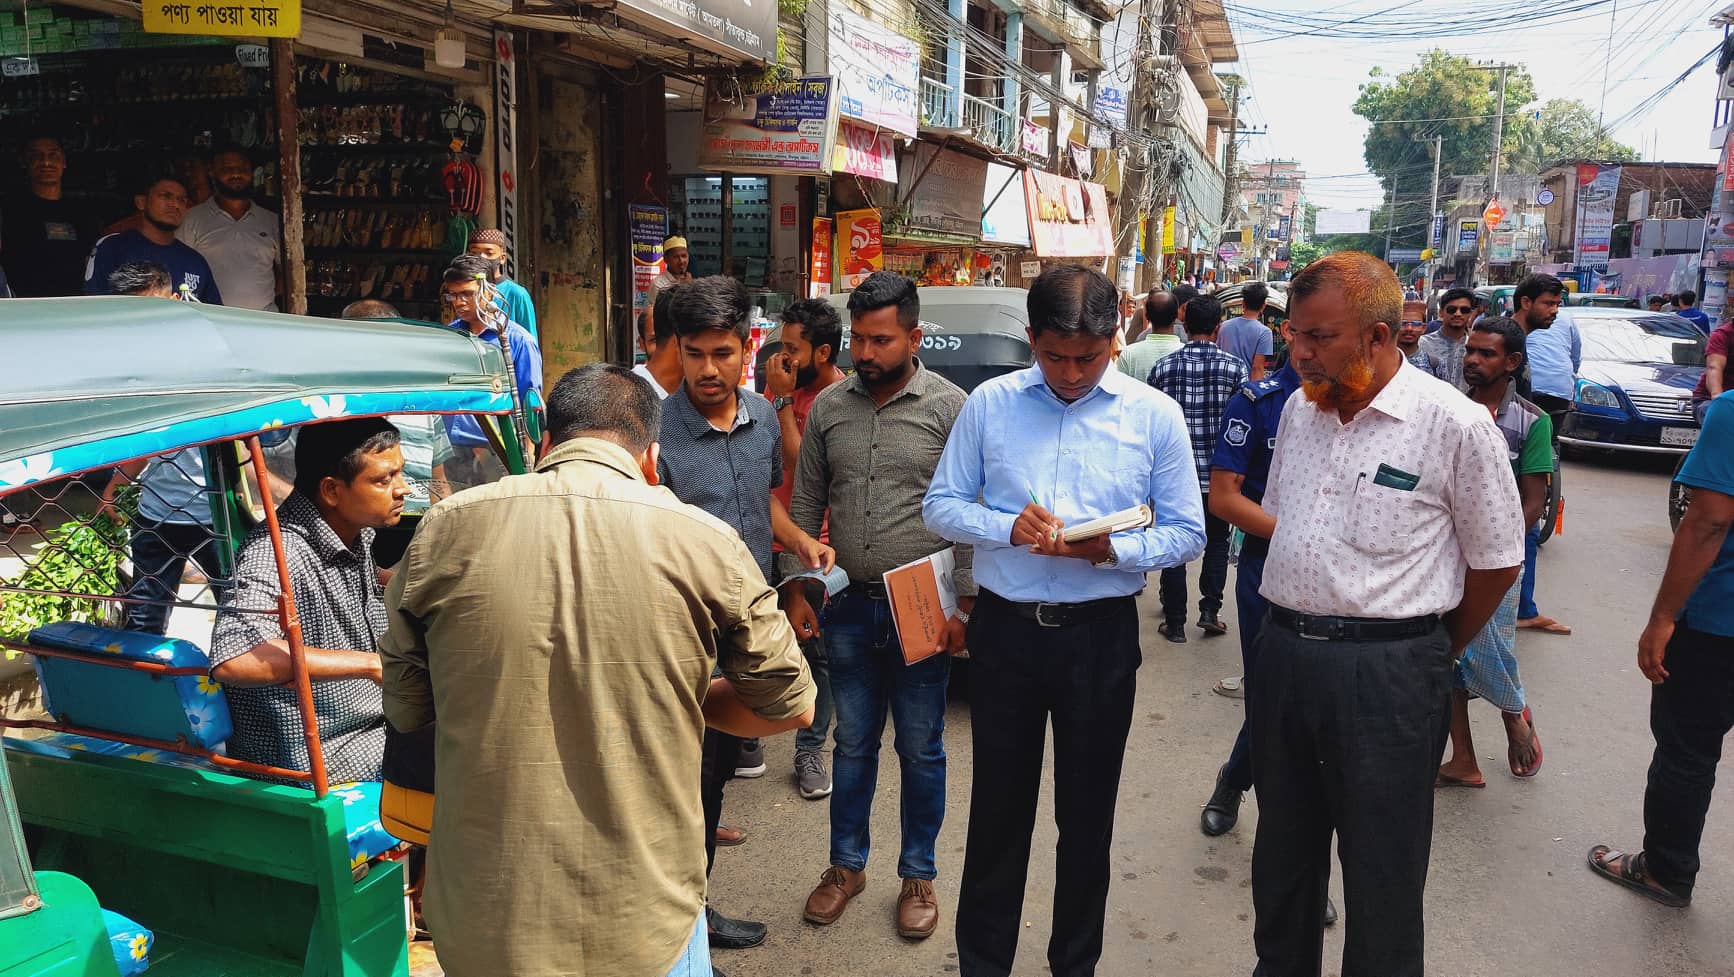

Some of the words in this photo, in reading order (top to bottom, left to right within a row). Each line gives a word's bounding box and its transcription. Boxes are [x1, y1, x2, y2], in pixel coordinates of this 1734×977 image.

[161, 6, 190, 25] পণ্য
[196, 6, 244, 26] পাওয়া
[251, 6, 279, 27] যায়
[500, 63, 511, 152] LOTTO
[504, 196, 515, 281] LOTTO
